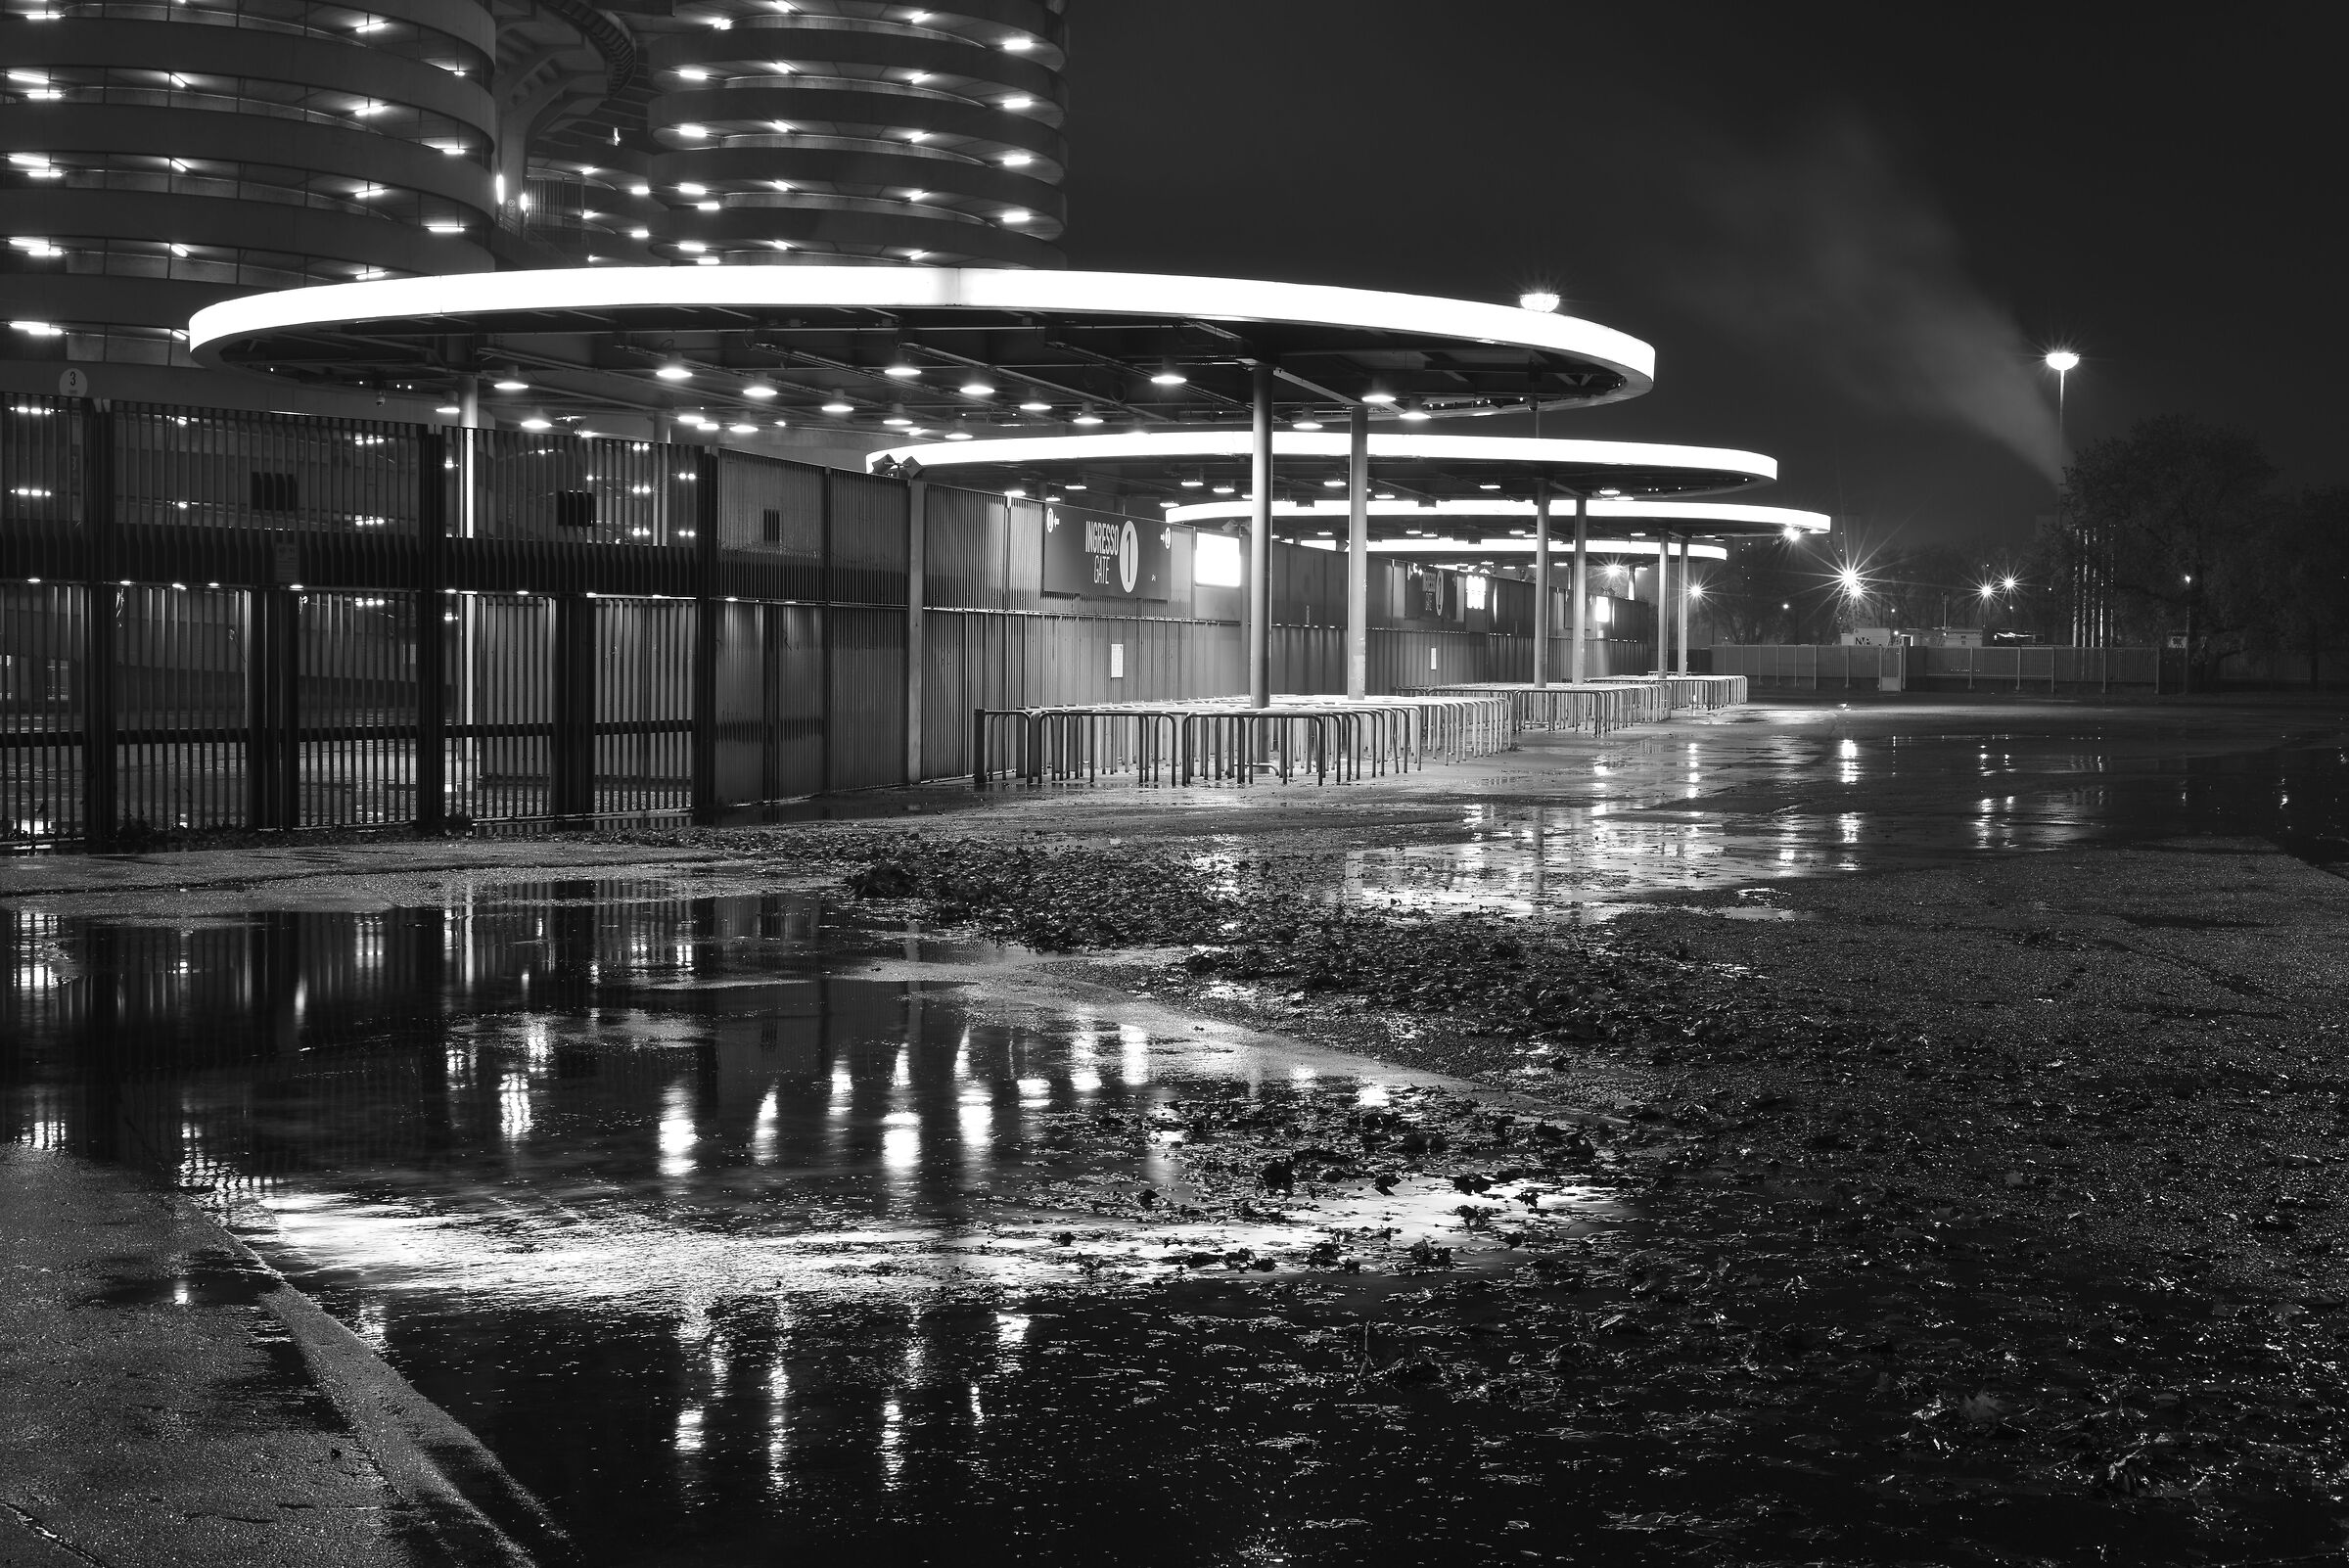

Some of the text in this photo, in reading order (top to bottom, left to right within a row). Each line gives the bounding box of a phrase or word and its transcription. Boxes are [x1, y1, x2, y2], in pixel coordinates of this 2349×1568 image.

[69, 371, 77, 386] 3
[1085, 521, 1120, 556] INGRESSO
[1093, 556, 1111, 584] GATE
